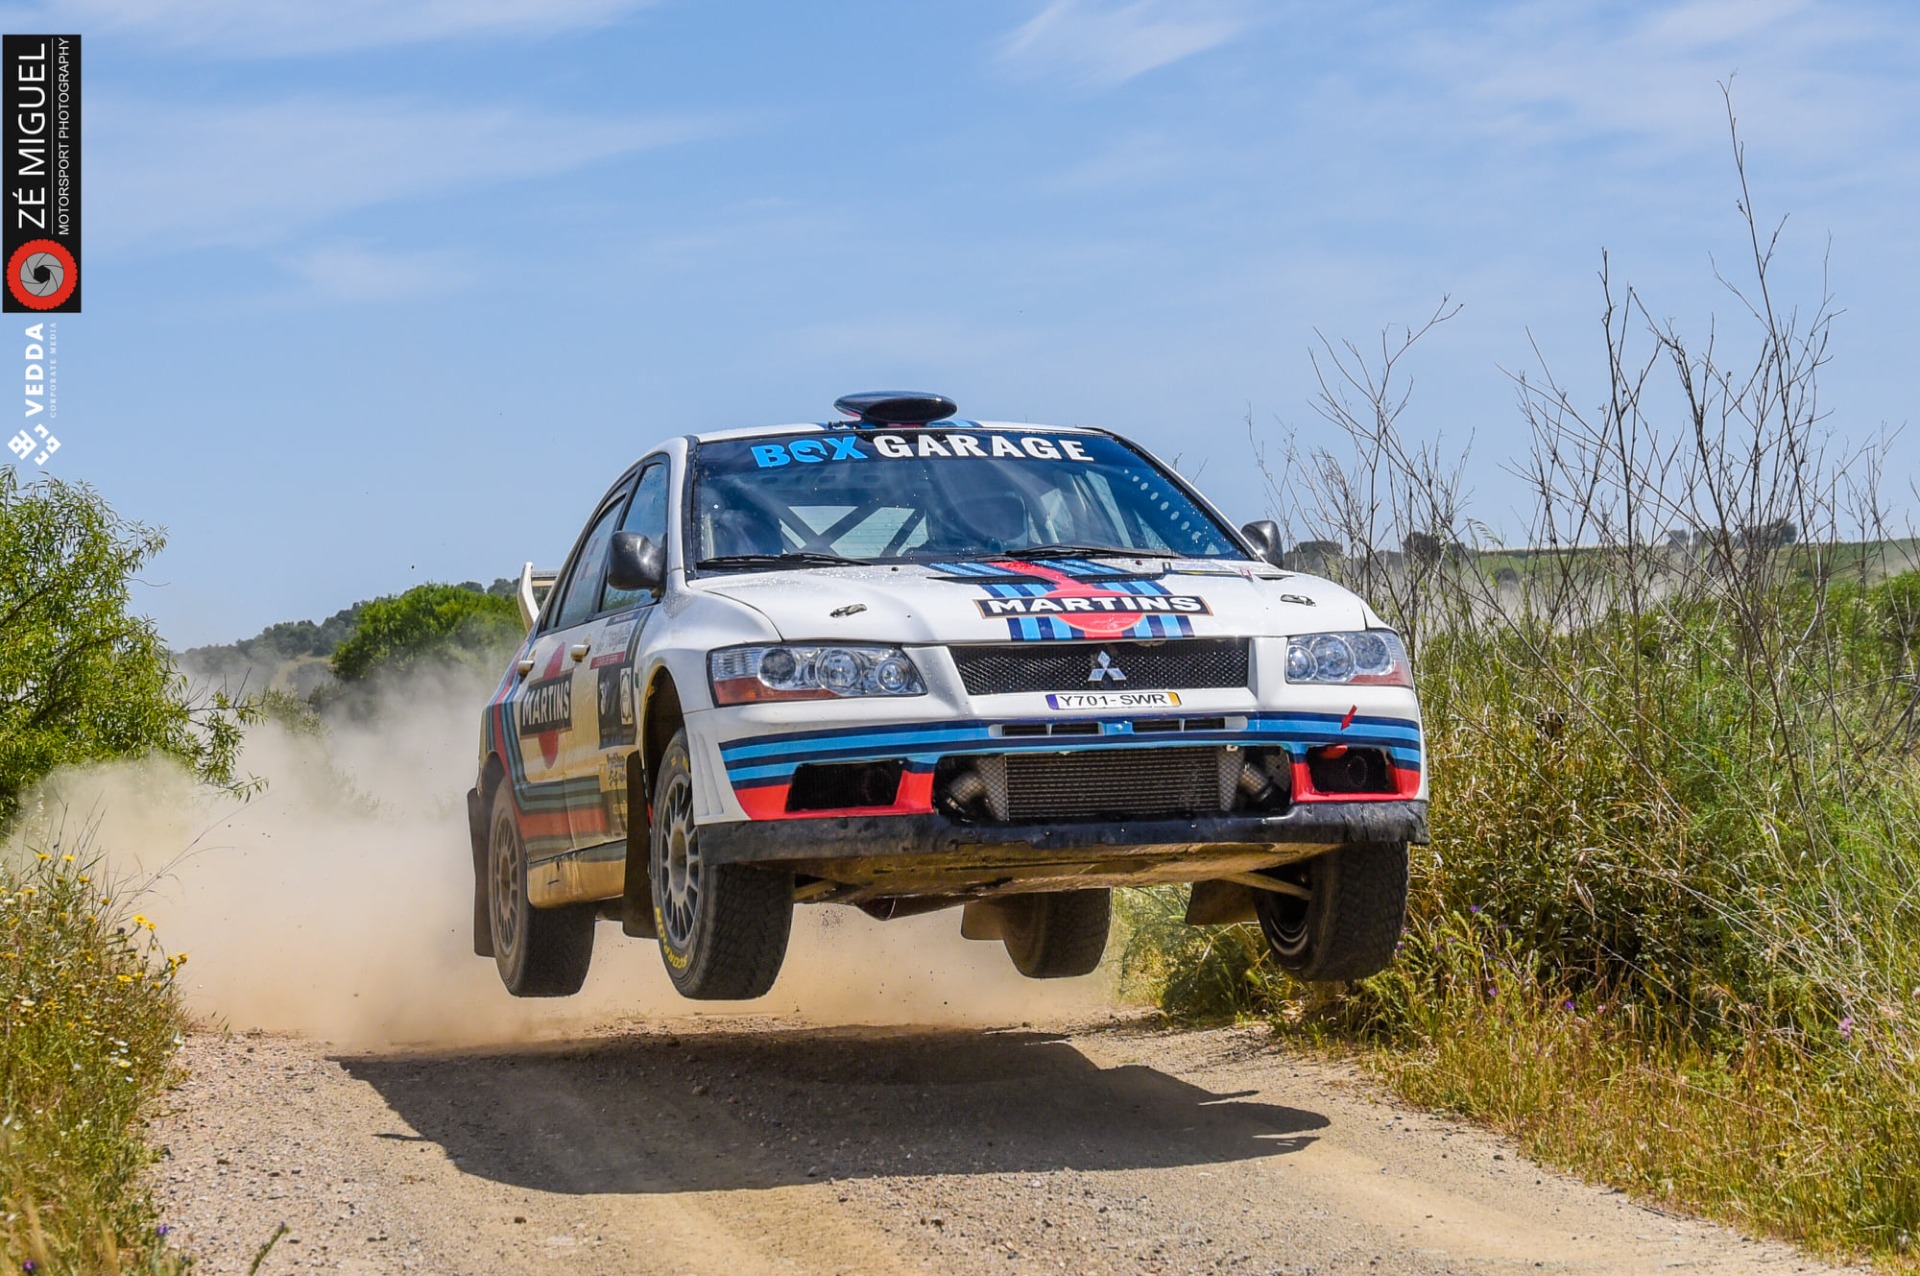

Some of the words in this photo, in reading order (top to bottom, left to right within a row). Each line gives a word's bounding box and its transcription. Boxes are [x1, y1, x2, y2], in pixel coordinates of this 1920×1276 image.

[751, 436, 868, 468] BOX
[873, 434, 1094, 462] GARAGE
[987, 597, 1202, 613] MARTINS
[522, 680, 570, 727] MARTINS
